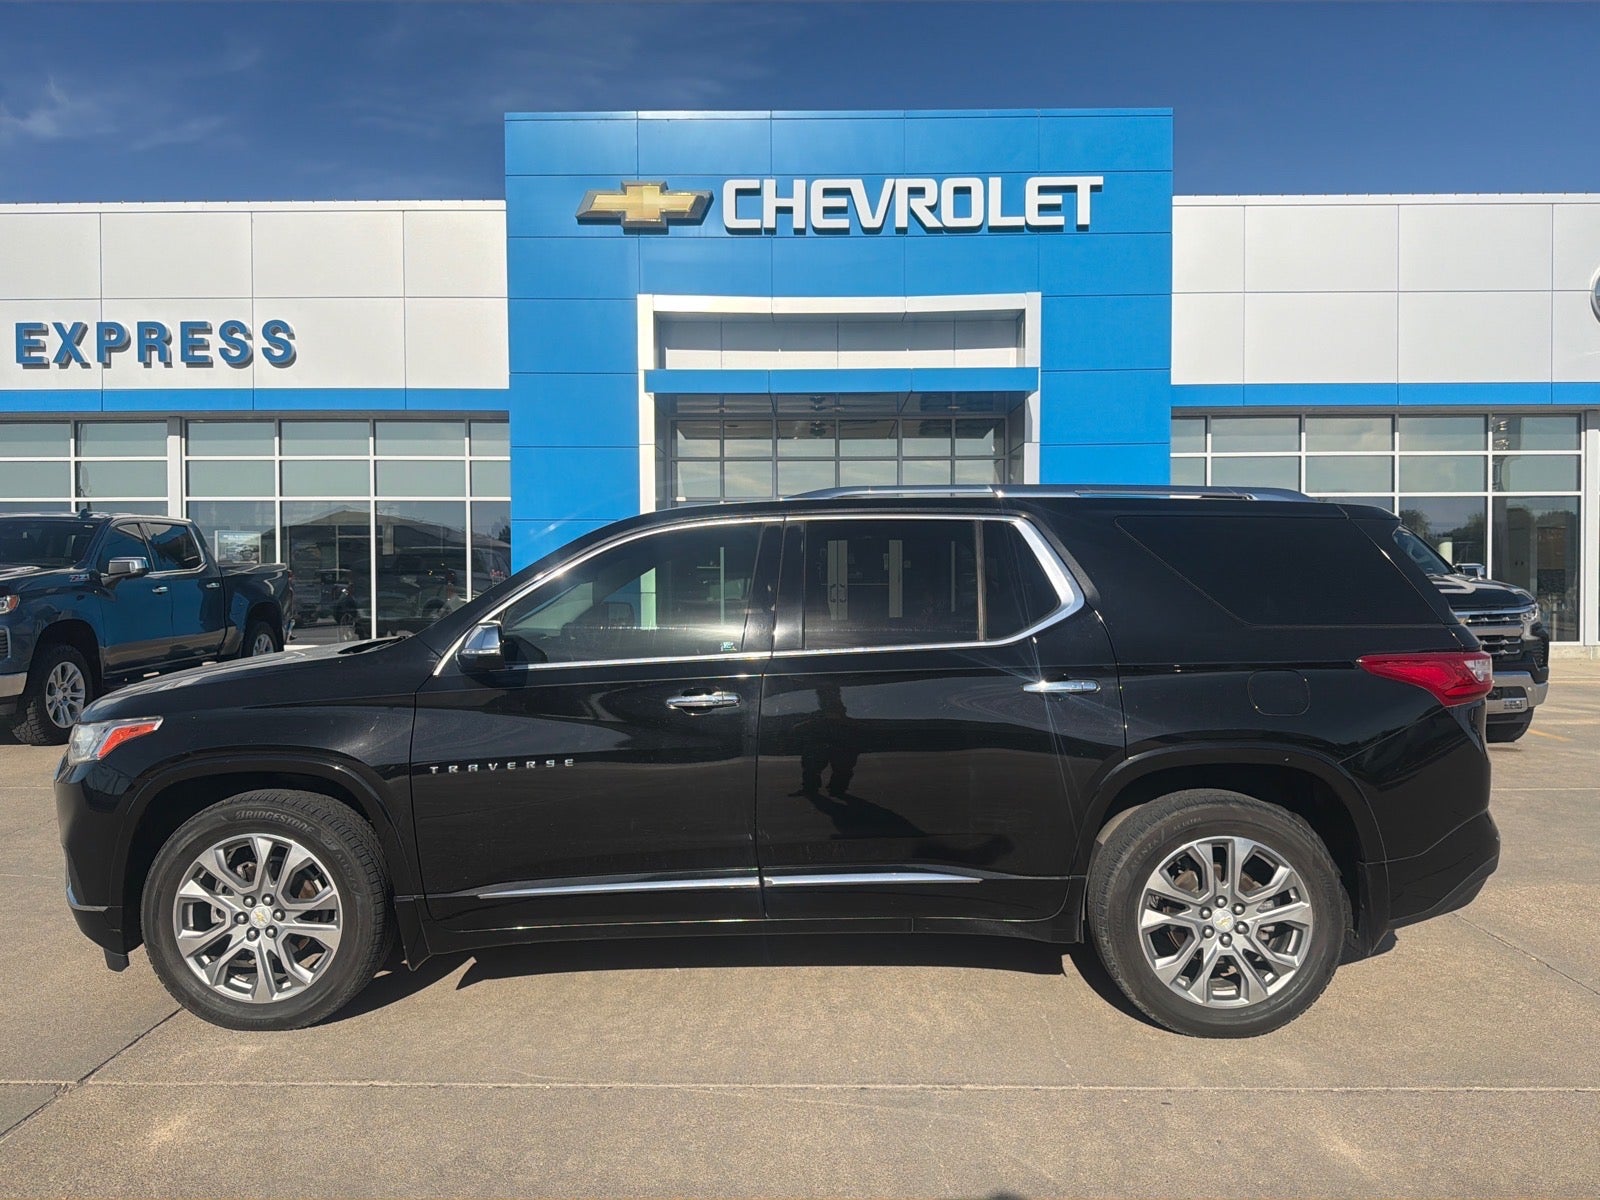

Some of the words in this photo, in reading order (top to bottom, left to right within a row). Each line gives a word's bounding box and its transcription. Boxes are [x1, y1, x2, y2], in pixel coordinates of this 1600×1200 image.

[722, 175, 1104, 232] CHEVROLET
[15, 319, 297, 368] EXPRESS
[429, 758, 575, 775] TRAVERSE
[235, 809, 316, 834] BRIDGESTONE
